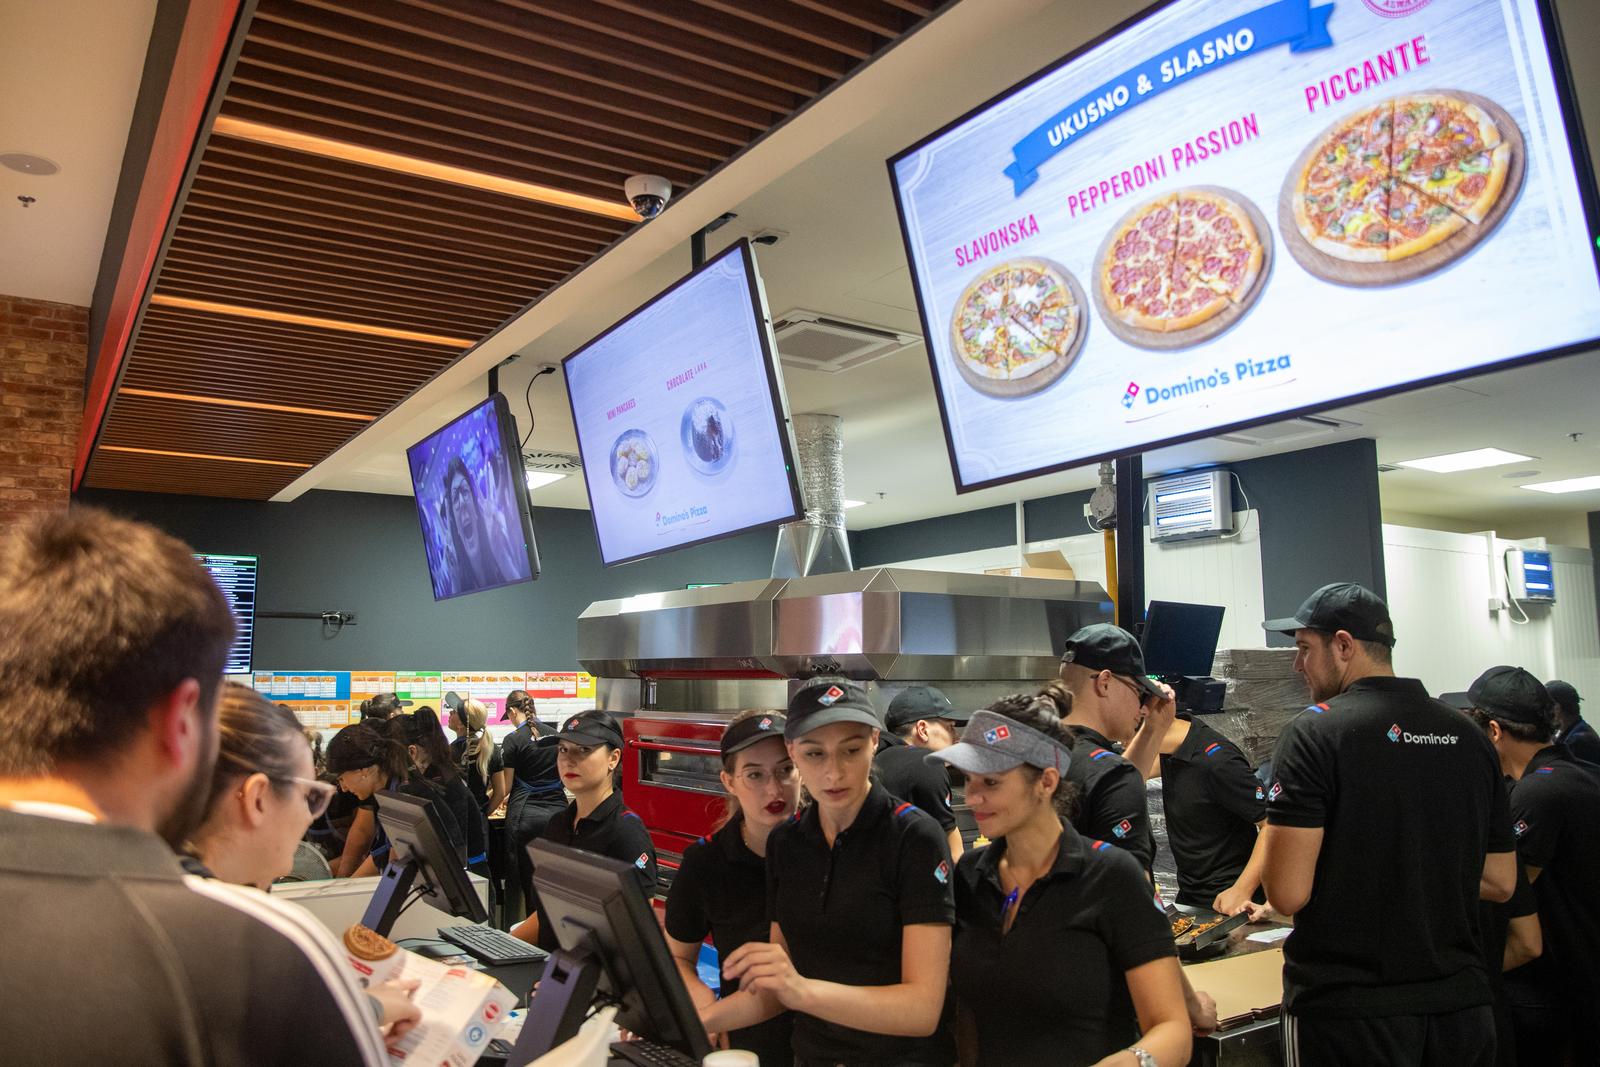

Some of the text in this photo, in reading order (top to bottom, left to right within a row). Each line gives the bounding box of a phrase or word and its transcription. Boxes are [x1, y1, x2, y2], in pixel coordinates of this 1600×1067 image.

[1047, 28, 1255, 149] UKUSNO & SLASNO
[1304, 35, 1431, 112] PICCANTE
[1067, 113, 1260, 218] PEPPERONI PASSION
[955, 214, 1040, 267] SLAVONSKA
[666, 368, 694, 391] CHOCOLATE
[1145, 354, 1292, 405] Domino's Pizza
[690, 506, 708, 518] Pizza
[1403, 732, 1457, 744] Domino's
